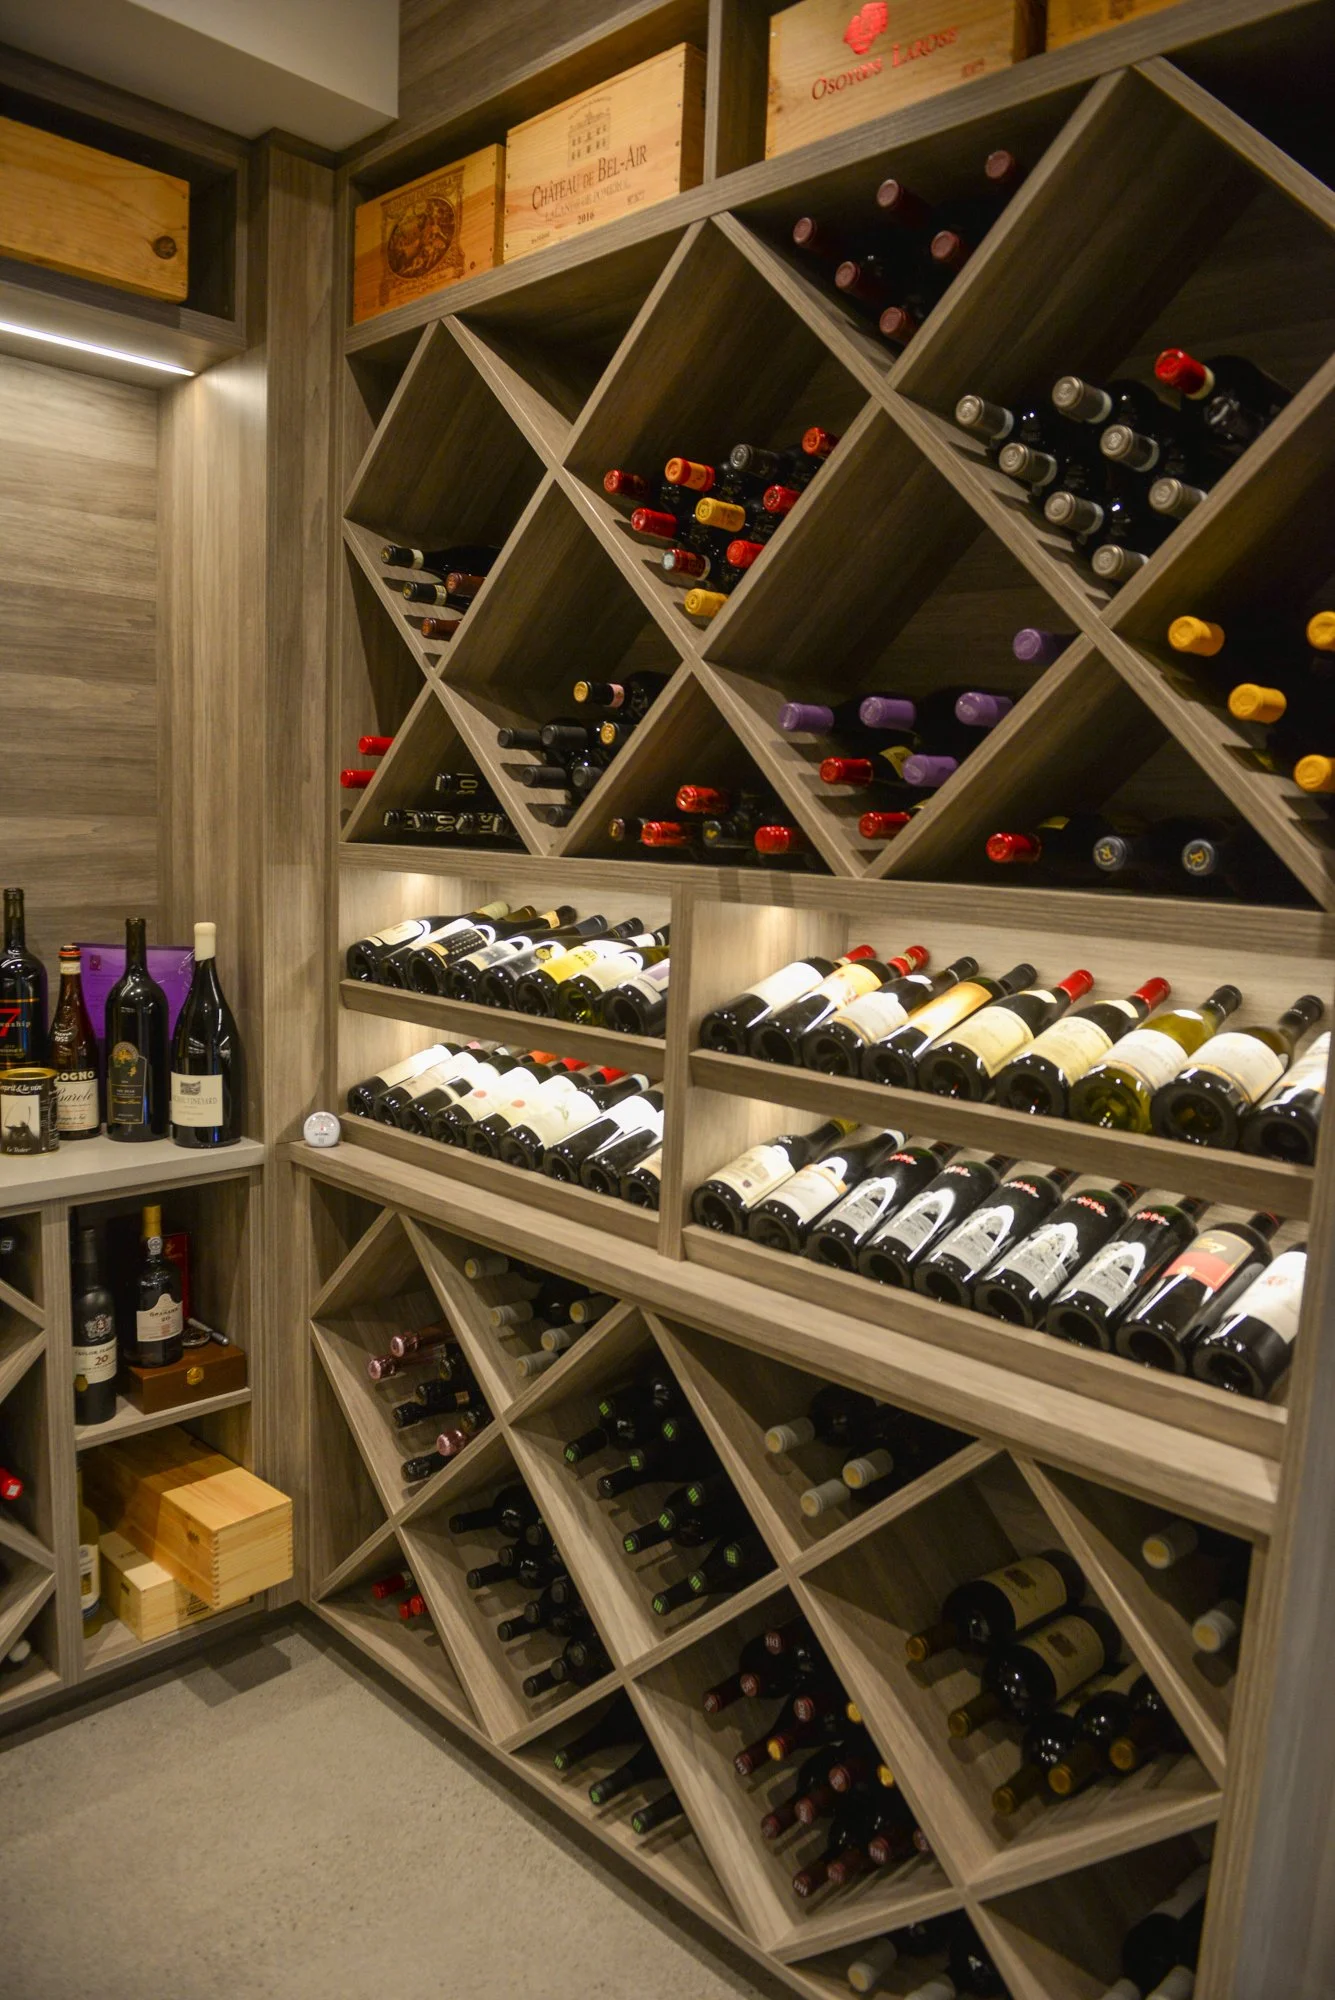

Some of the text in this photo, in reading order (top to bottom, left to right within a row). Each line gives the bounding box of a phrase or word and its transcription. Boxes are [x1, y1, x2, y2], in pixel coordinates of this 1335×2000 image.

[891, 25, 959, 68] LAROSE
[583, 172, 594, 187] DE
[597, 144, 648, 183] BEL-AIR
[577, 211, 595, 225] 2016
[95, 1354, 109, 1366] 20
